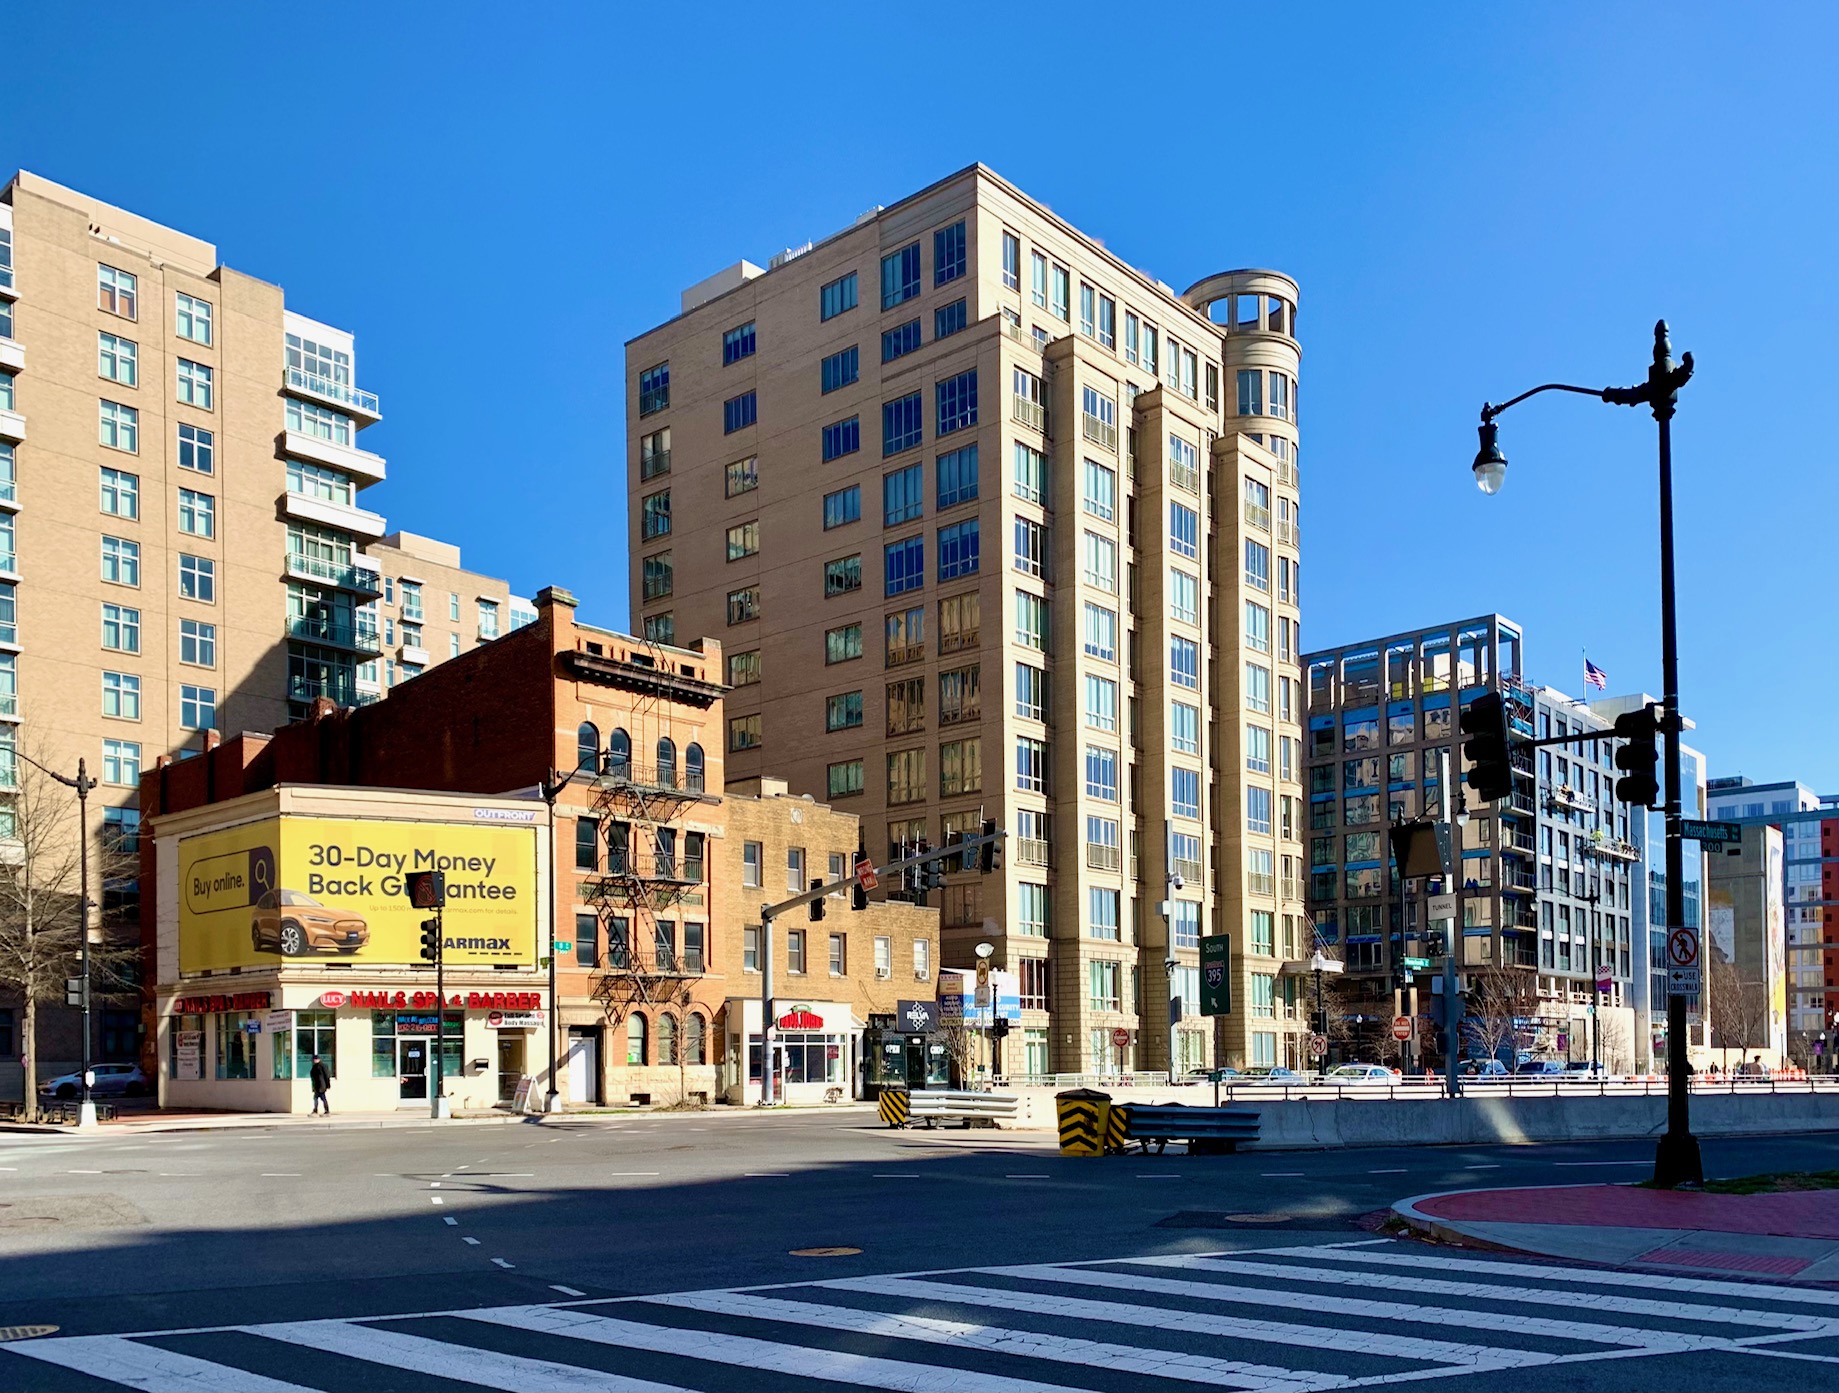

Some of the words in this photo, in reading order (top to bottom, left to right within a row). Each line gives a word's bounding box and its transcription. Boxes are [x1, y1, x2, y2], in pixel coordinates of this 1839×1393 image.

[1683, 822, 1728, 839] Massachusetts
[1702, 842, 1720, 851] 300
[308, 844, 407, 874] 30-Day
[414, 849, 496, 877] Money
[193, 877, 211, 900] Buy
[213, 872, 245, 891] online.
[308, 873, 373, 896] Back
[1207, 969, 1221, 982] 395
[1683, 972, 1696, 980] USE
[323, 995, 344, 1004] LUCY
[351, 991, 407, 1009] NAILS
[452, 994, 463, 1006] &
[468, 992, 541, 1009] BARBER
[780, 1012, 798, 1028] PAPA
